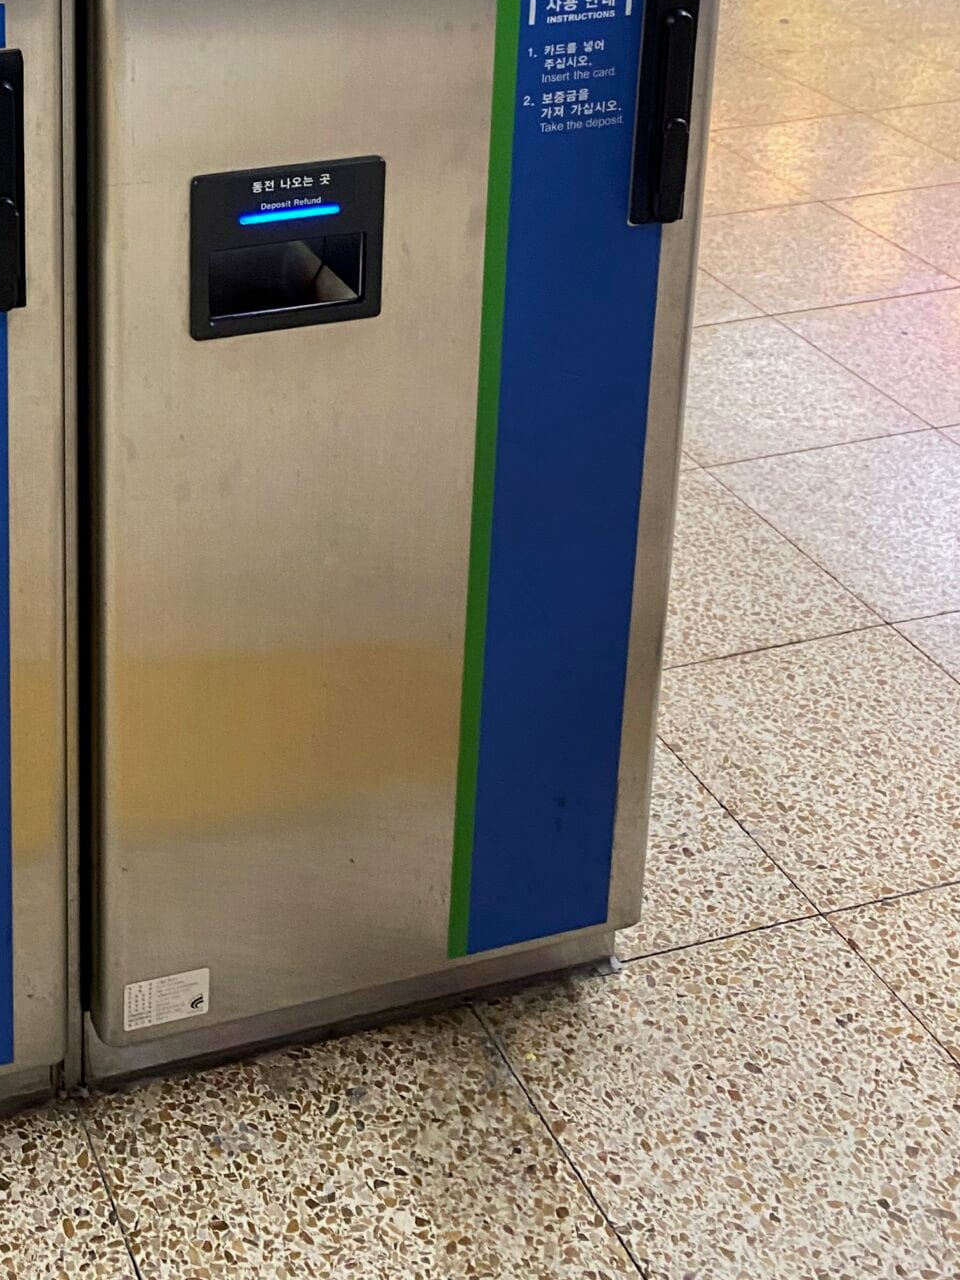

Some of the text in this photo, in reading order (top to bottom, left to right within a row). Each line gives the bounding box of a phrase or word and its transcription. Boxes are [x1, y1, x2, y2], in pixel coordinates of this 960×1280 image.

[546, 10, 616, 24] INSTRUCTIONS
[527, 40, 605, 58] 1. 카드를 넣어
[544, 55, 592, 71] 주십시오.
[541, 72, 570, 83] Insert
[574, 69, 590, 80] the
[523, 88, 589, 107] 2. 보증금을
[541, 100, 622, 119] 가져 가십시오.
[540, 122, 564, 132] Take
[567, 119, 582, 129] the
[252, 173, 331, 193] 동전 나오는 곳
[260, 196, 322, 211] Deposit Refund
